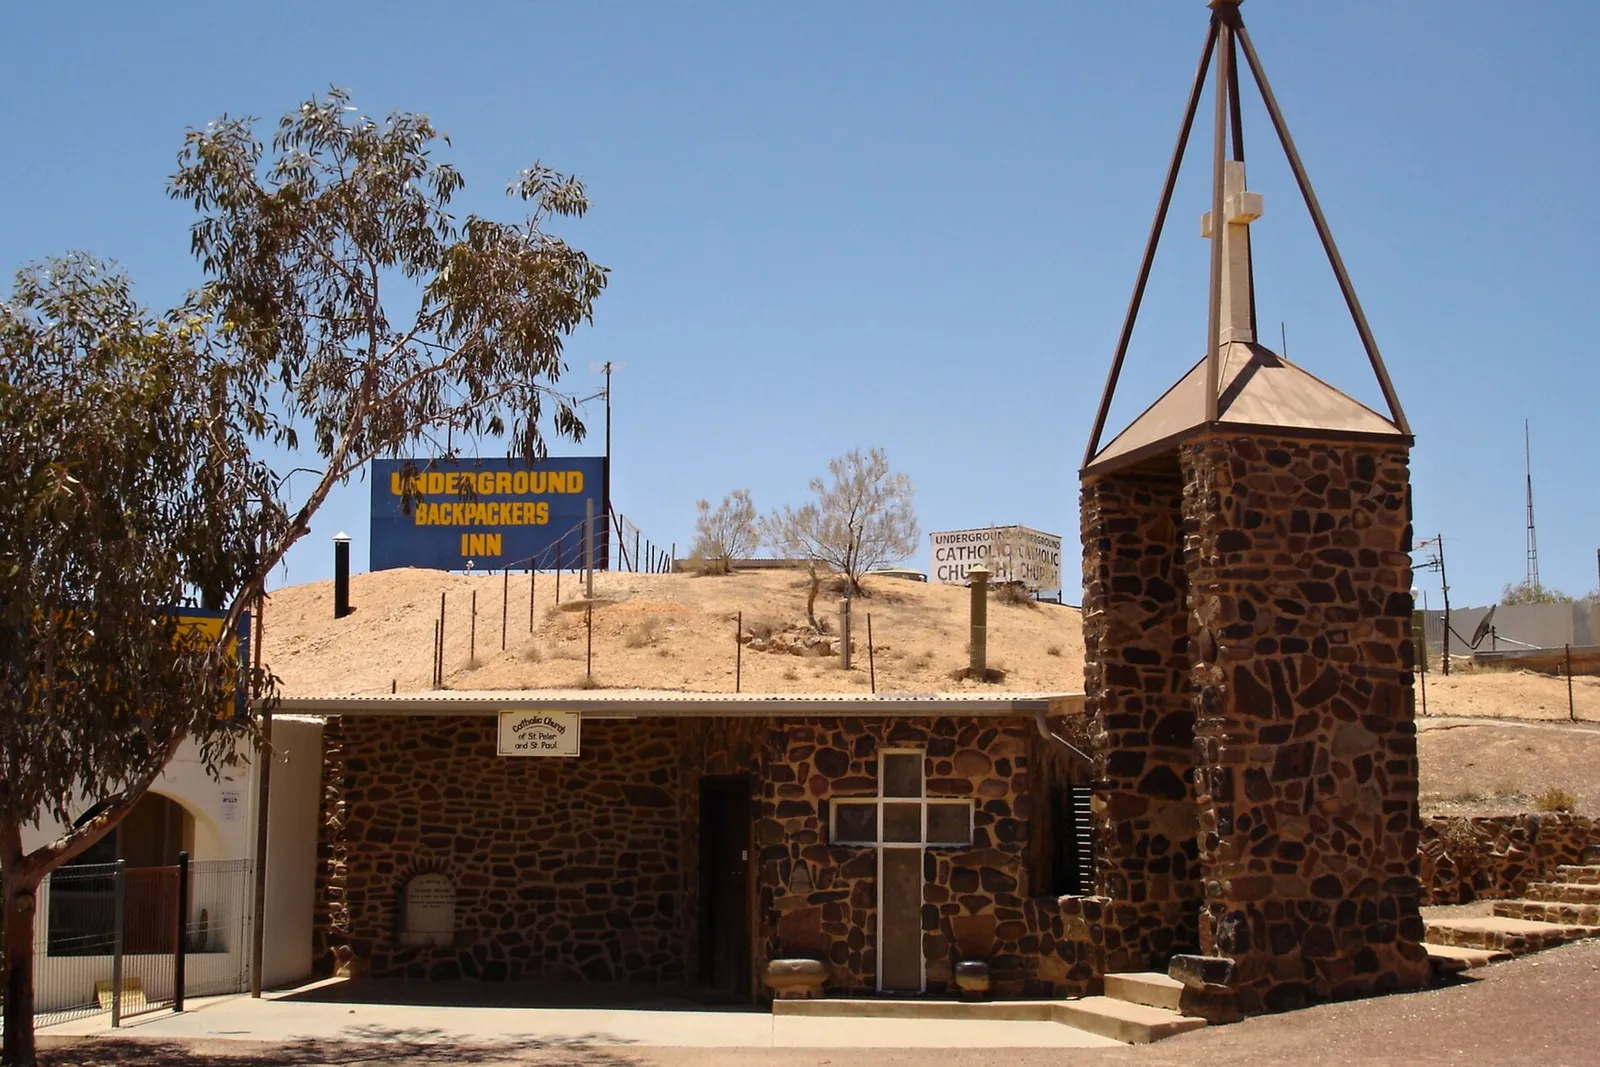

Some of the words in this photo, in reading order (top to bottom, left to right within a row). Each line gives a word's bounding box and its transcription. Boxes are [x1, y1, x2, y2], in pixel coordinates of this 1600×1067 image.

[390, 471, 584, 495] UNDERGROUND
[415, 502, 549, 525] BACKPACKERS
[461, 533, 501, 556] INN
[1017, 531, 1060, 550] UERGROUND
[937, 561, 1007, 581] CHUH
[512, 716, 542, 733] Catholic
[543, 716, 566, 735] Church
[518, 732, 526, 740] of
[538, 732, 557, 740] Peter
[541, 741, 557, 749] Paul
